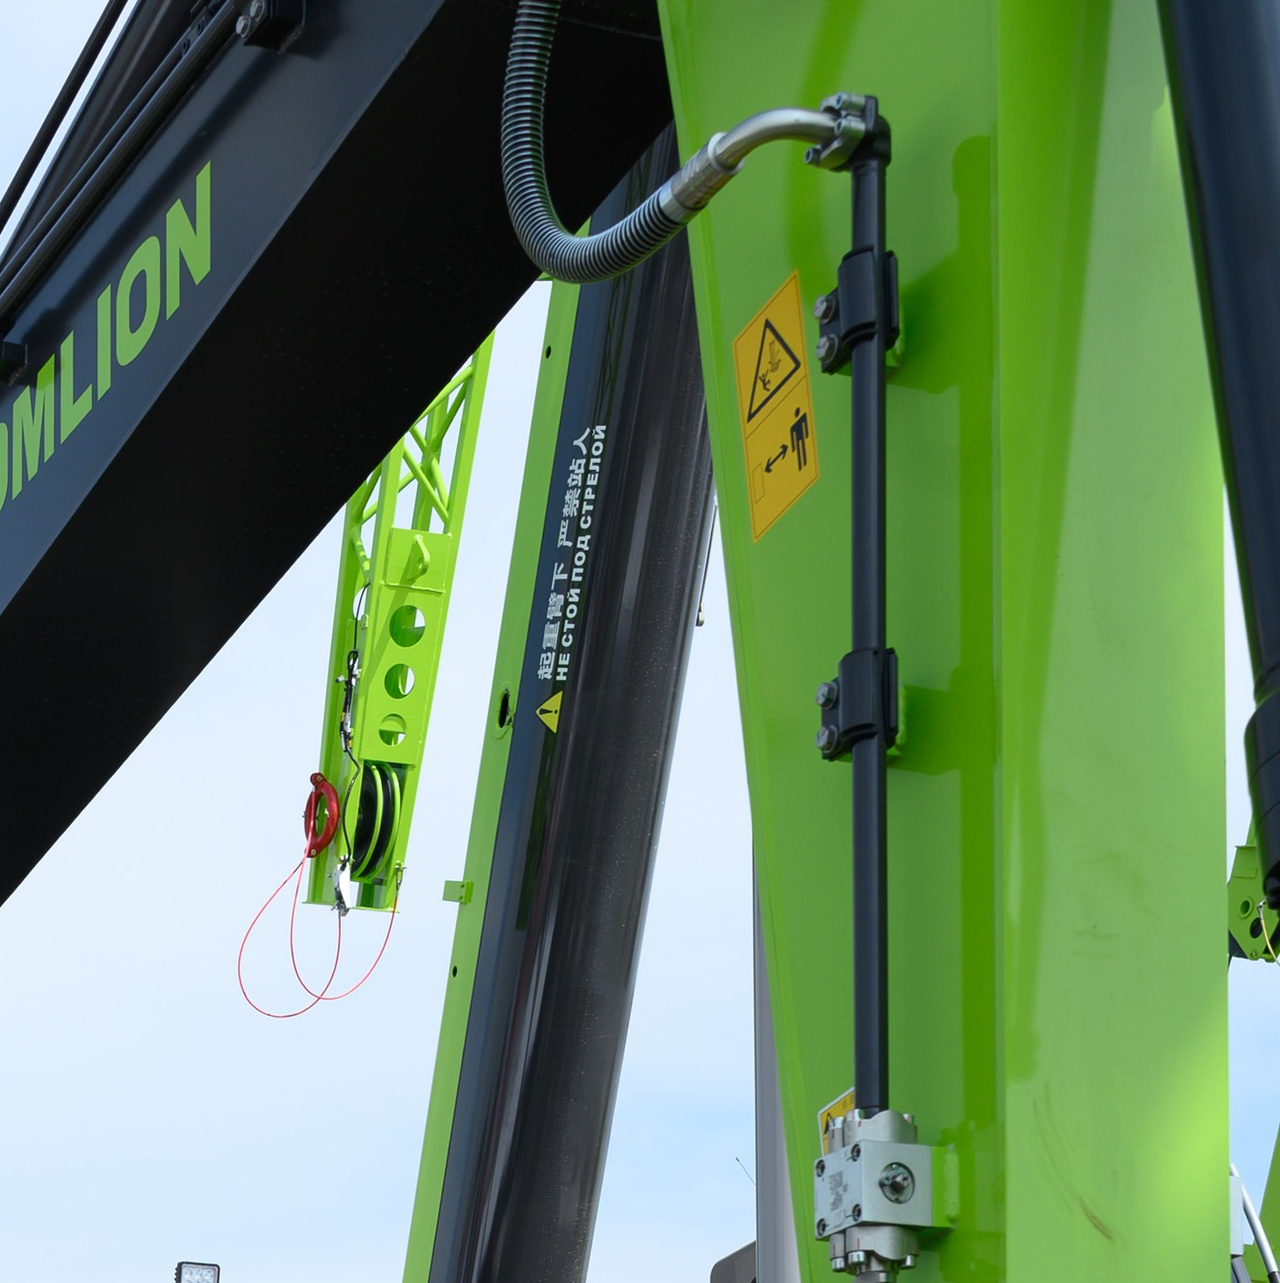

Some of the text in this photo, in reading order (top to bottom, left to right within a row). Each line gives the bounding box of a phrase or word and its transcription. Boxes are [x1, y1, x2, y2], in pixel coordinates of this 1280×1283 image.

[555, 425, 607, 681] НЕ СТОЙ ПОД СТРЕЛОЙ
